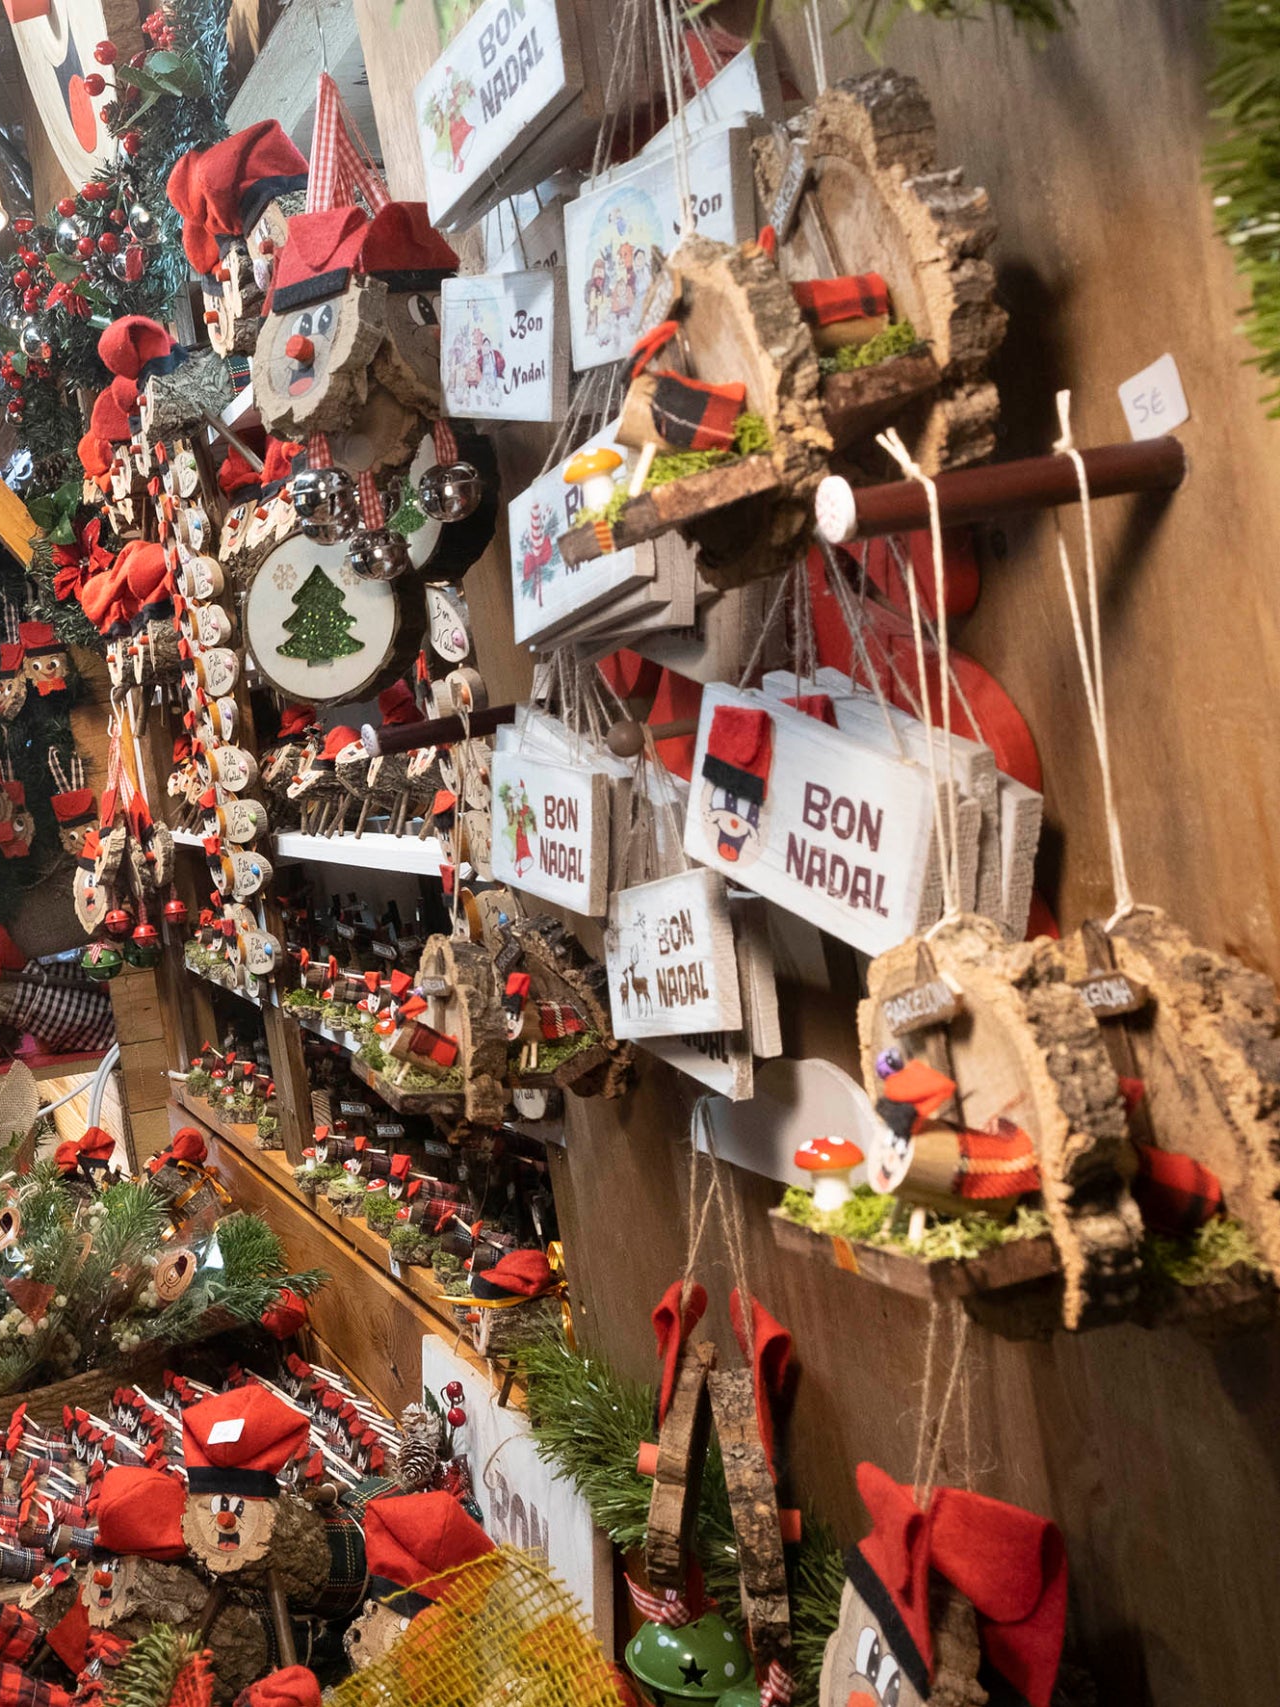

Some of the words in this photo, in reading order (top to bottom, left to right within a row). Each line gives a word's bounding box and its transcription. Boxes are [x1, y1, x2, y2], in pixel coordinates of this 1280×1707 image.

[480, 26, 544, 124] NADAL
[510, 310, 543, 339] Bon
[504, 360, 545, 394] Nadal
[544, 795, 578, 832] BON
[803, 781, 883, 852] BON
[540, 836, 584, 883] NADAL
[786, 831, 888, 918] NADAL
[657, 909, 694, 955] BON
[656, 961, 709, 1008] NADAL
